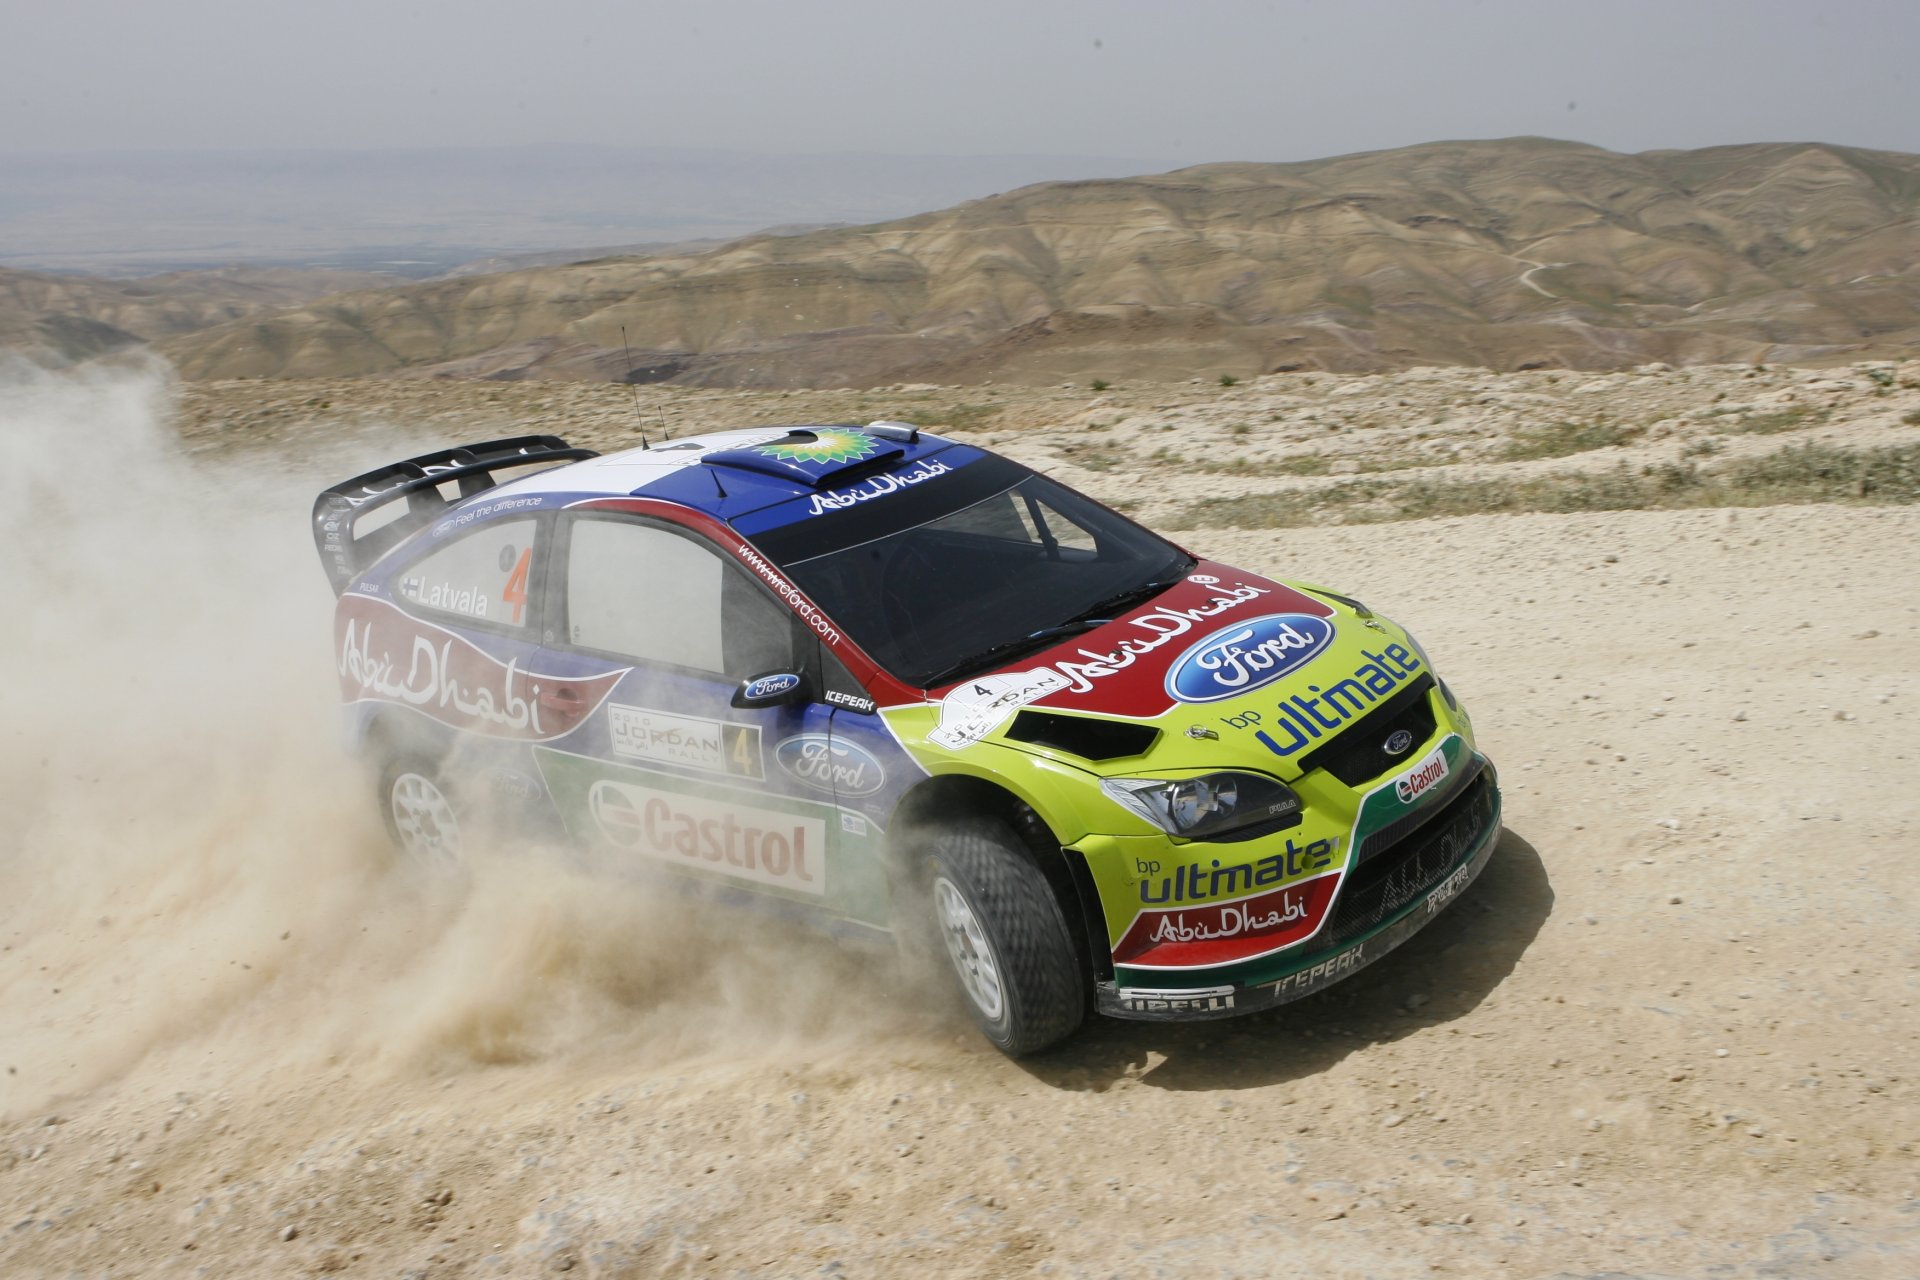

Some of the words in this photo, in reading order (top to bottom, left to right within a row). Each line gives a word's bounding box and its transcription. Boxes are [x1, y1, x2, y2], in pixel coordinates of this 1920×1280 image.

[455, 510, 477, 527] Feel
[476, 506, 493, 519] the
[493, 497, 543, 513] difference
[419, 574, 489, 617] Latvala
[502, 547, 532, 624] 4
[1196, 622, 1315, 687] Ford
[754, 677, 790, 696] Ford
[824, 690, 877, 712] ICEPEAK
[973, 684, 993, 697] 4
[1220, 710, 1262, 730] bp
[1255, 643, 1421, 757] ultimate
[614, 713, 650, 726] 2010
[615, 722, 718, 753] JORDAN
[732, 728, 753, 775] 4
[1392, 733, 1408, 750] Ford
[668, 747, 719, 763] RALLY
[796, 741, 866, 789] Ford
[1410, 756, 1444, 794] Castrol
[644, 797, 814, 882] Castrol
[1136, 857, 1161, 877] bp
[1140, 839, 1332, 904] ultimate
